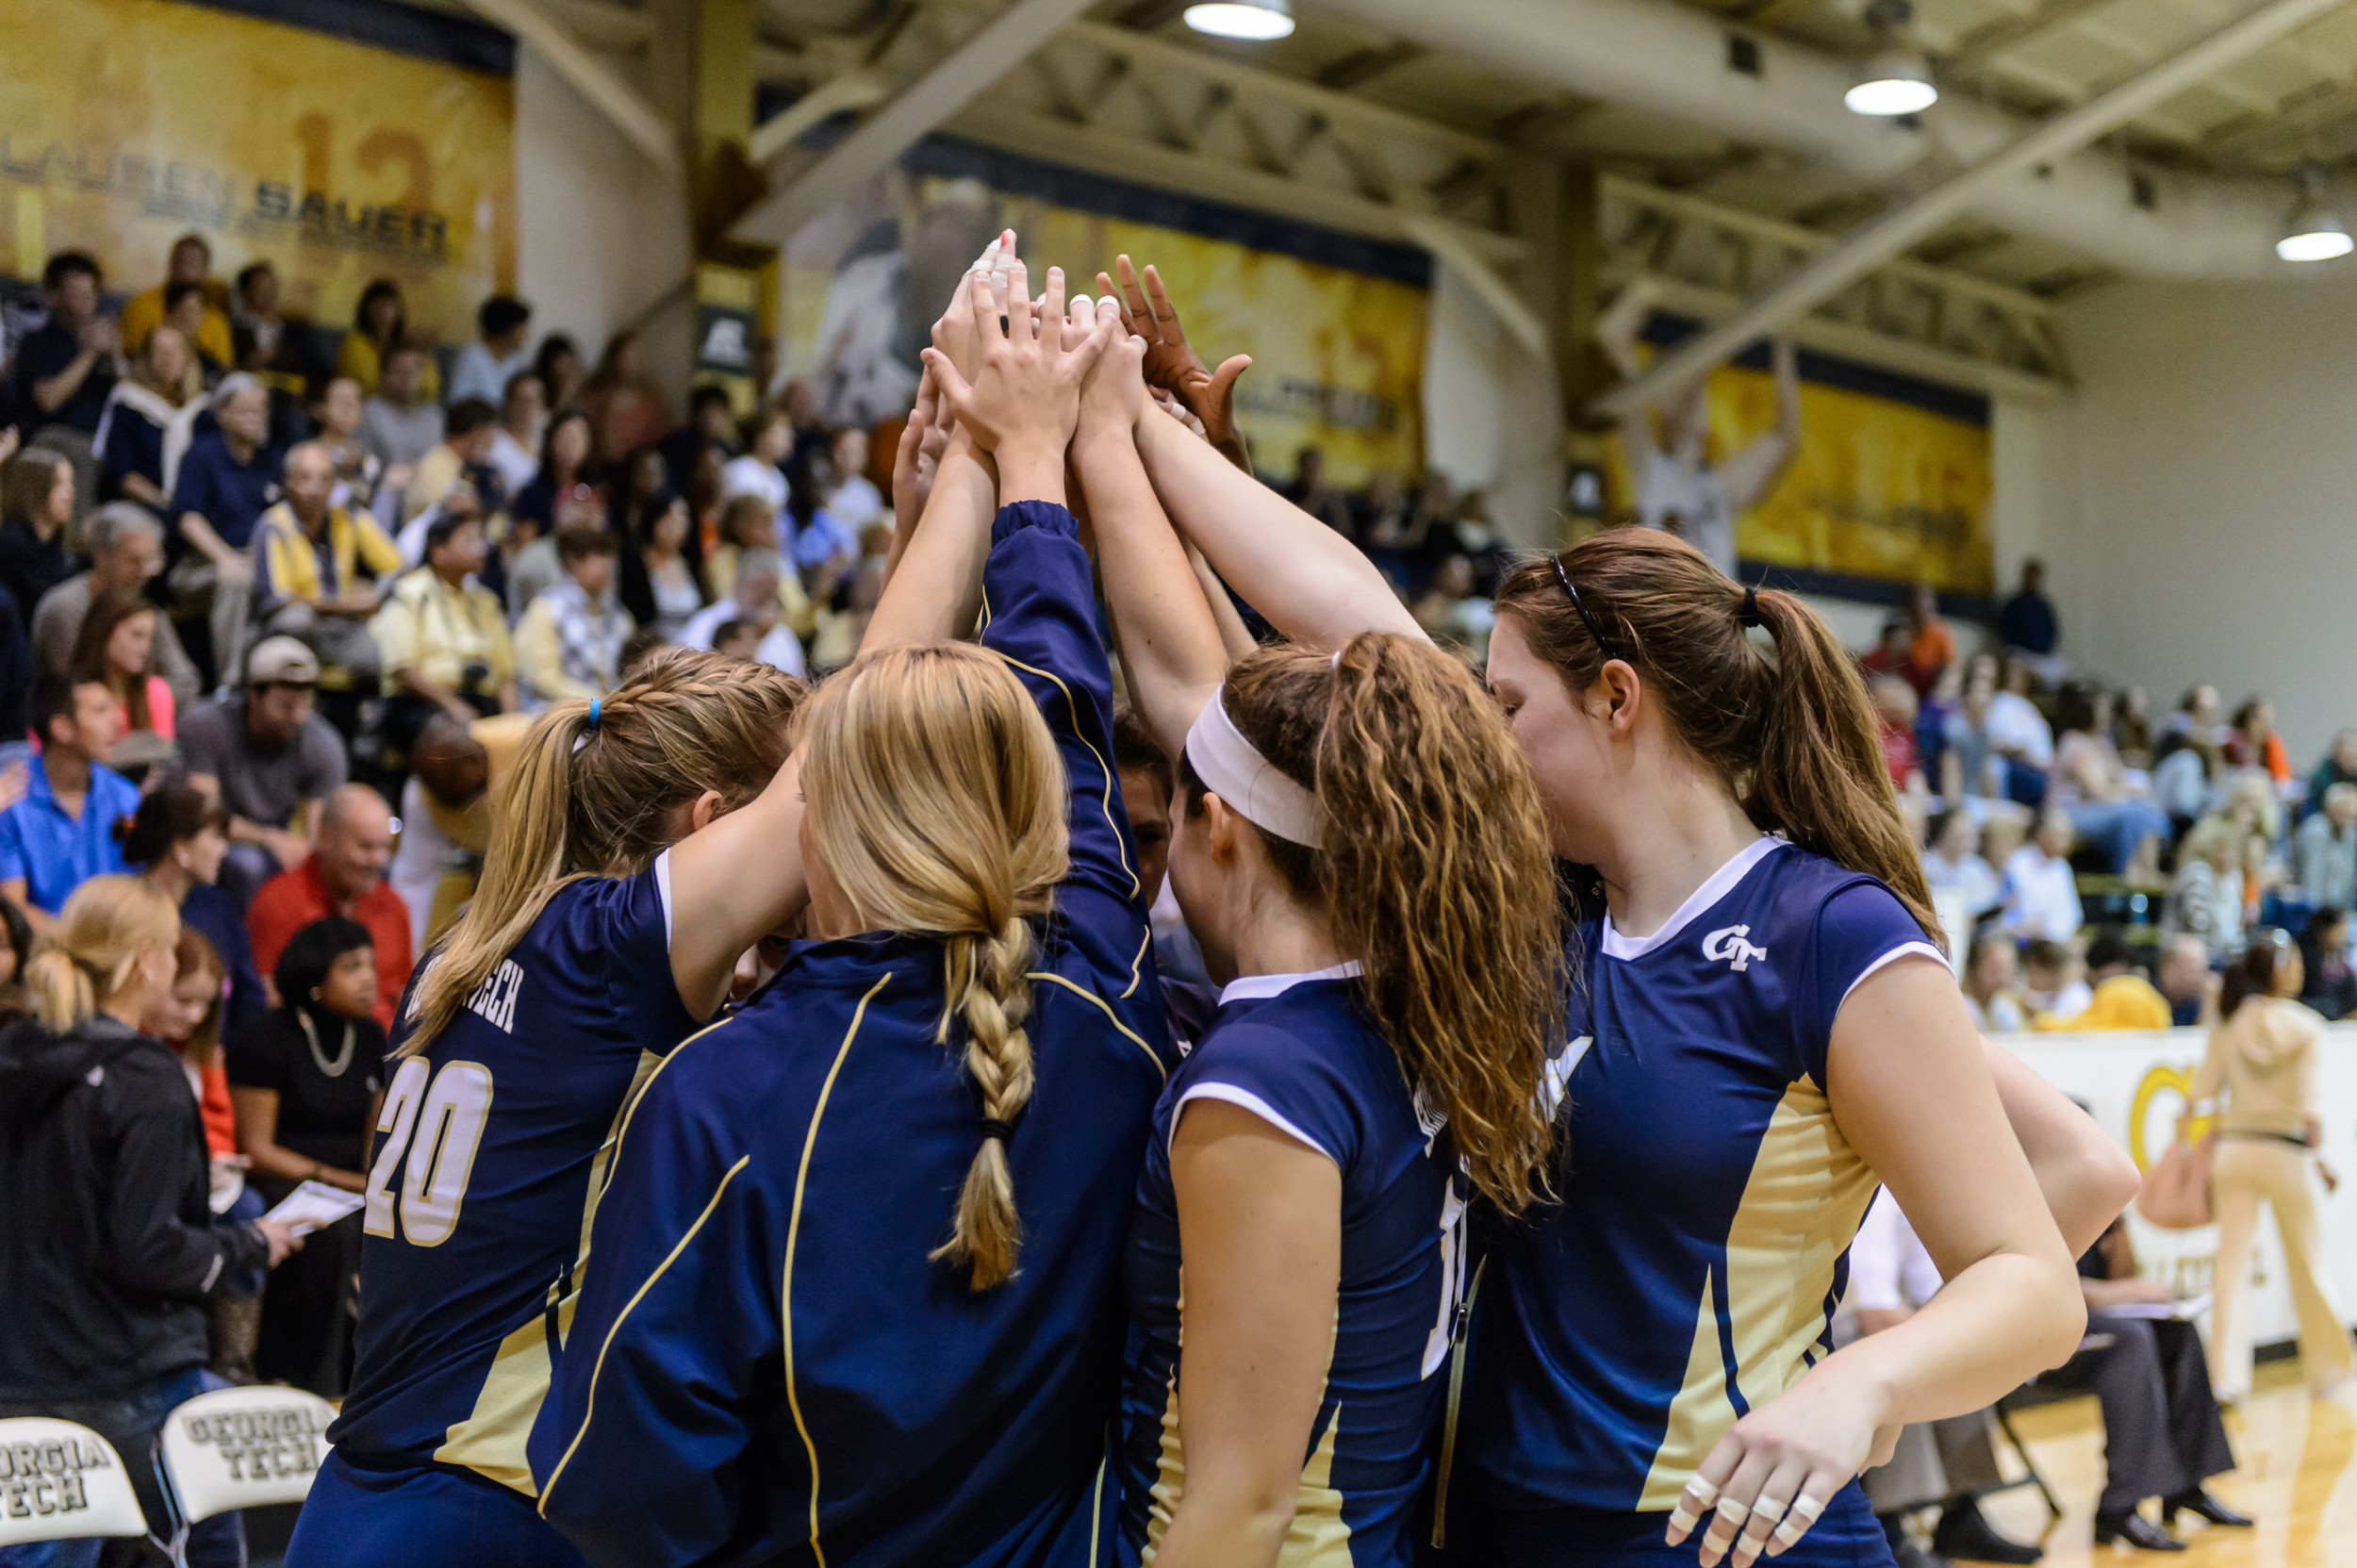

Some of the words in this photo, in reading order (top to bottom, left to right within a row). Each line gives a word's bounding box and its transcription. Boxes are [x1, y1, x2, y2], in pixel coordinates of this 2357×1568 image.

[255, 181, 450, 254] SAUER
[1702, 923, 1768, 972] GT
[363, 1055, 494, 1247] 20
[219, 1441, 319, 1480] TECH
[0, 1475, 89, 1518] ECH
